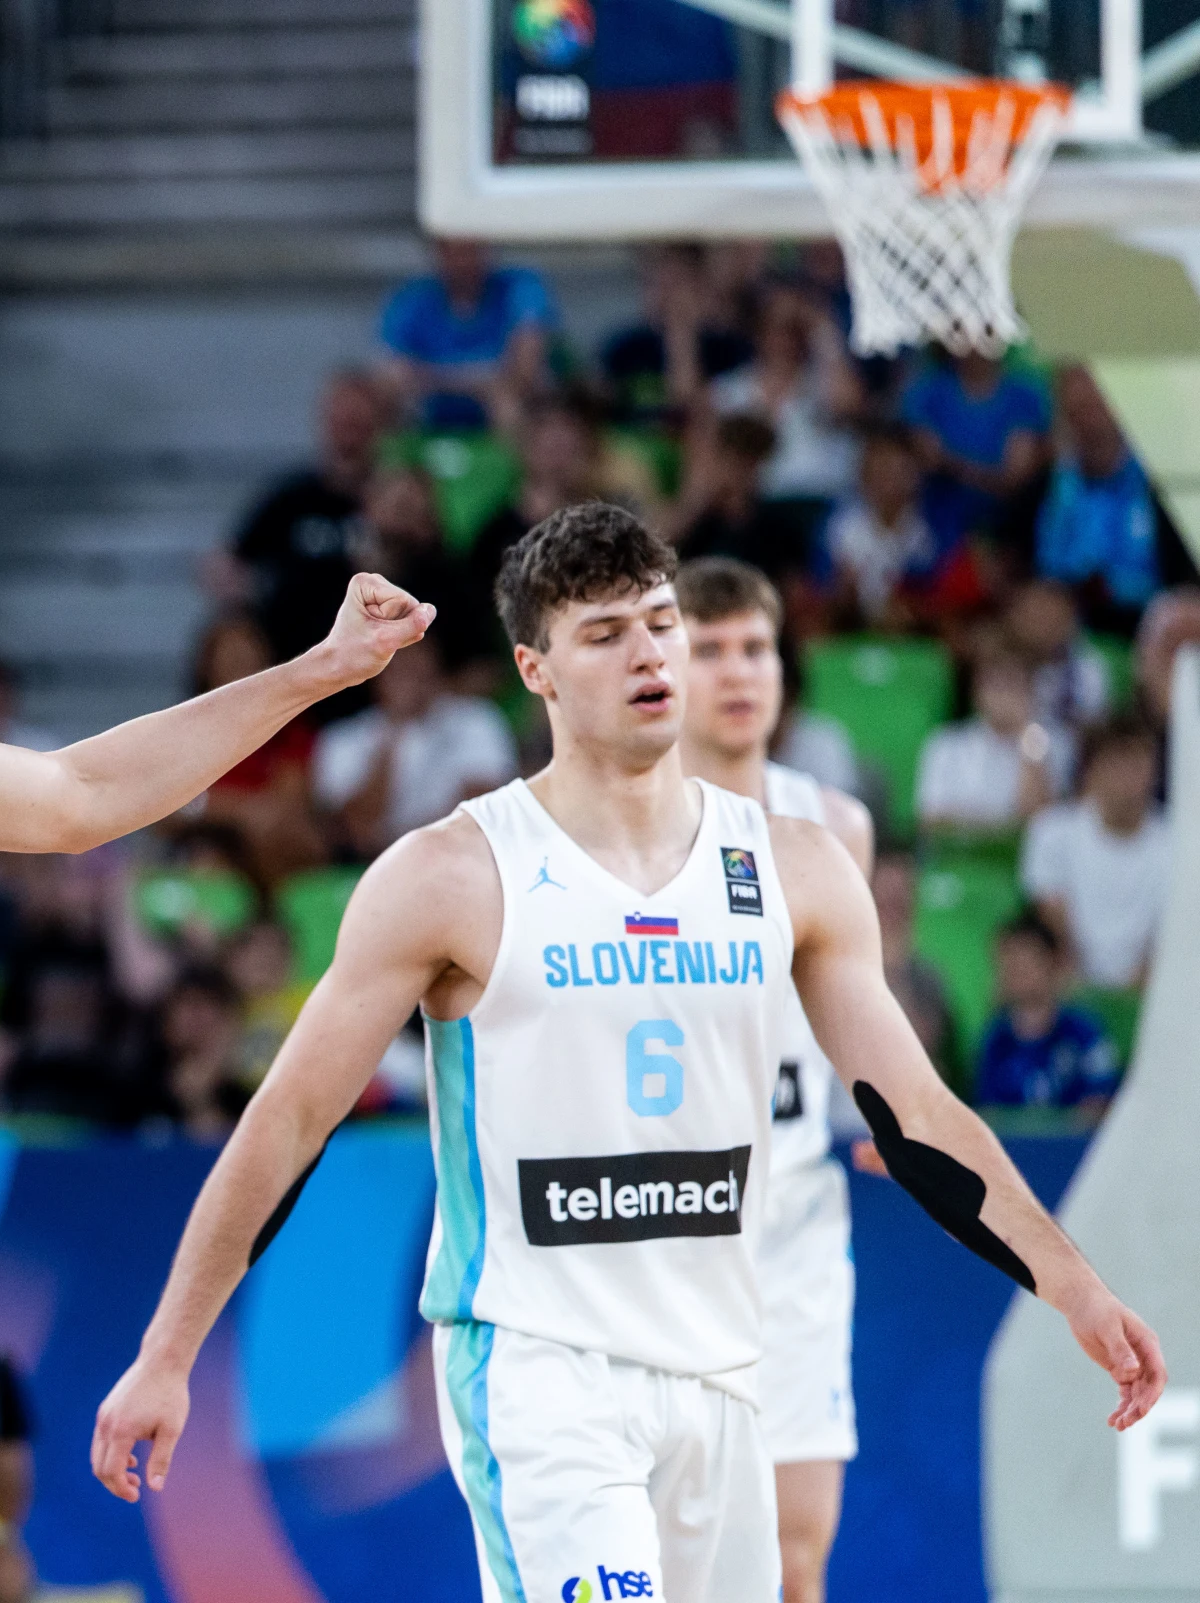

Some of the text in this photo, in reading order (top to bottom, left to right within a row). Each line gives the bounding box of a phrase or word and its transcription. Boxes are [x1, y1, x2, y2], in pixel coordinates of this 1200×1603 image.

[730, 884, 758, 900] FIBA
[543, 940, 764, 988] SLOVENIJA
[626, 1019, 685, 1117] 6
[597, 1565, 653, 1601] hse
